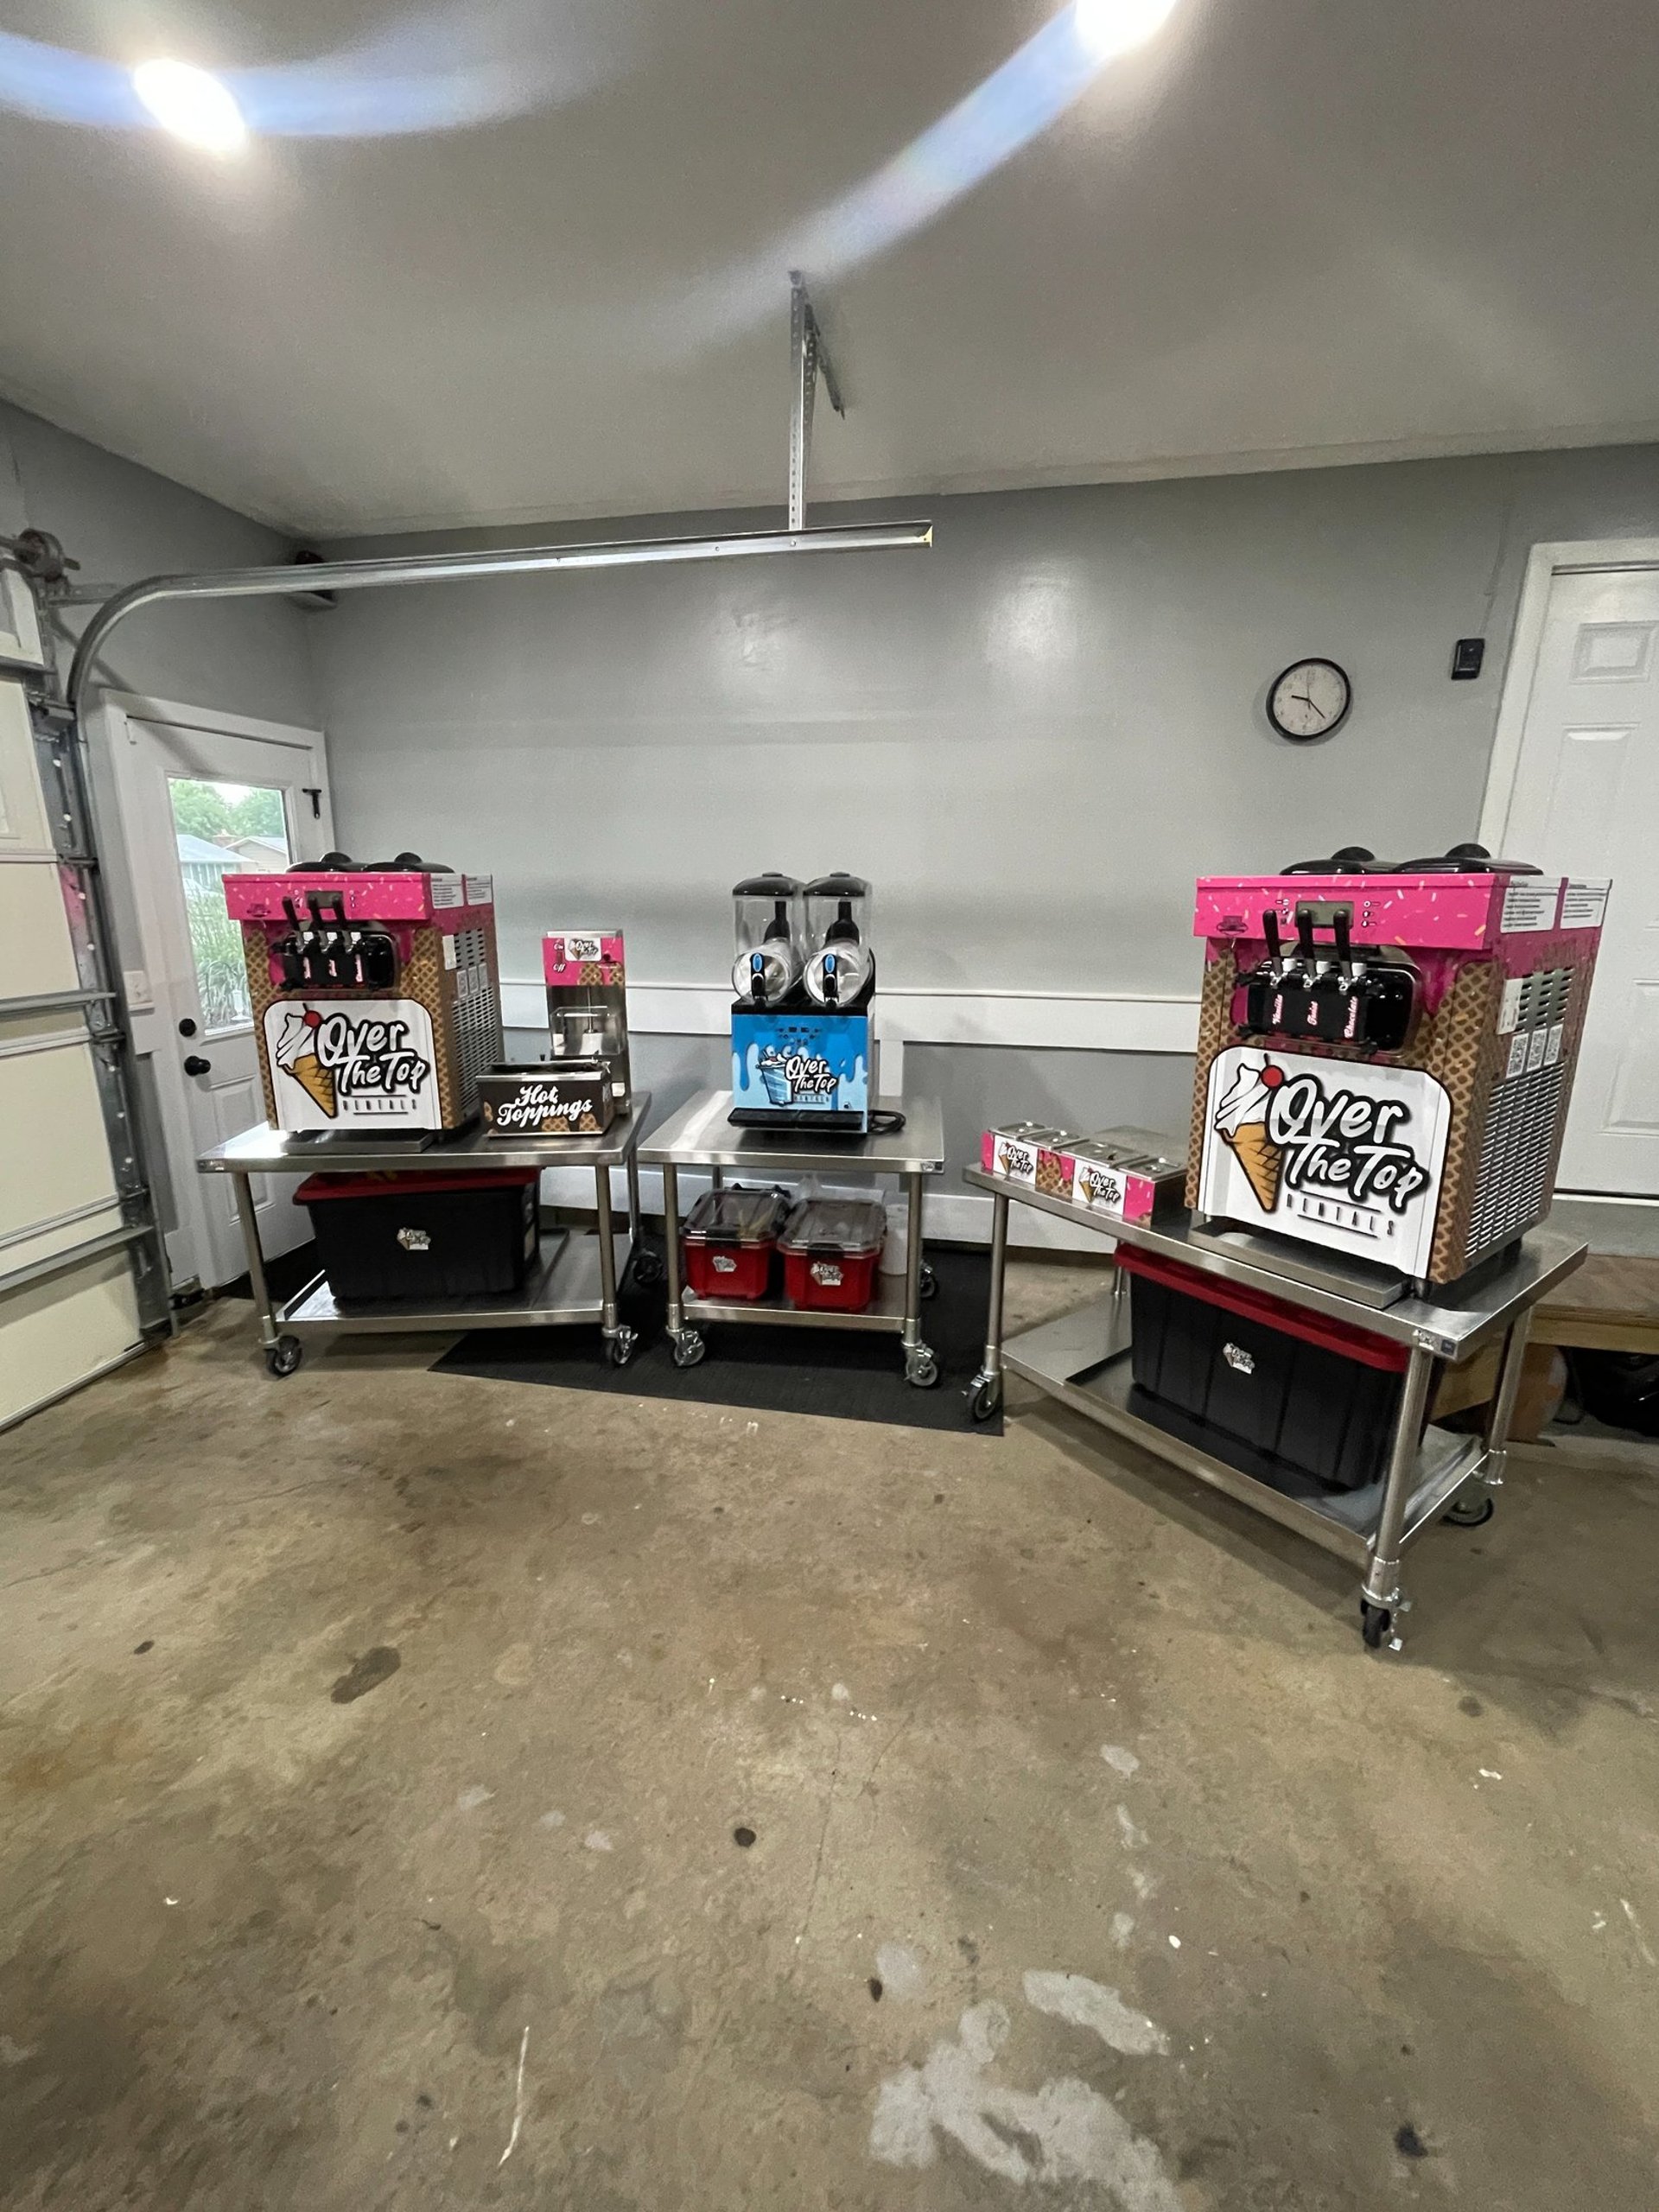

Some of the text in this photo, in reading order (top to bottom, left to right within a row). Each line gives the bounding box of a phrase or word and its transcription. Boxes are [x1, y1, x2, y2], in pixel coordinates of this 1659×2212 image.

[553, 963, 566, 972] Off
[317, 1016, 405, 1067] Over
[335, 1052, 426, 1093] The Top
[785, 1056, 827, 1080] Over
[515, 1084, 559, 1107] Hot
[791, 1073, 837, 1092] The Top
[497, 1099, 593, 1128] Toppings
[1269, 1077, 1403, 1145] Over
[1007, 1146, 1028, 1160] Over
[1090, 1172, 1115, 1187] Over
[1289, 1135, 1424, 1208] The Top
[1286, 1193, 1395, 1236] RENTALS
